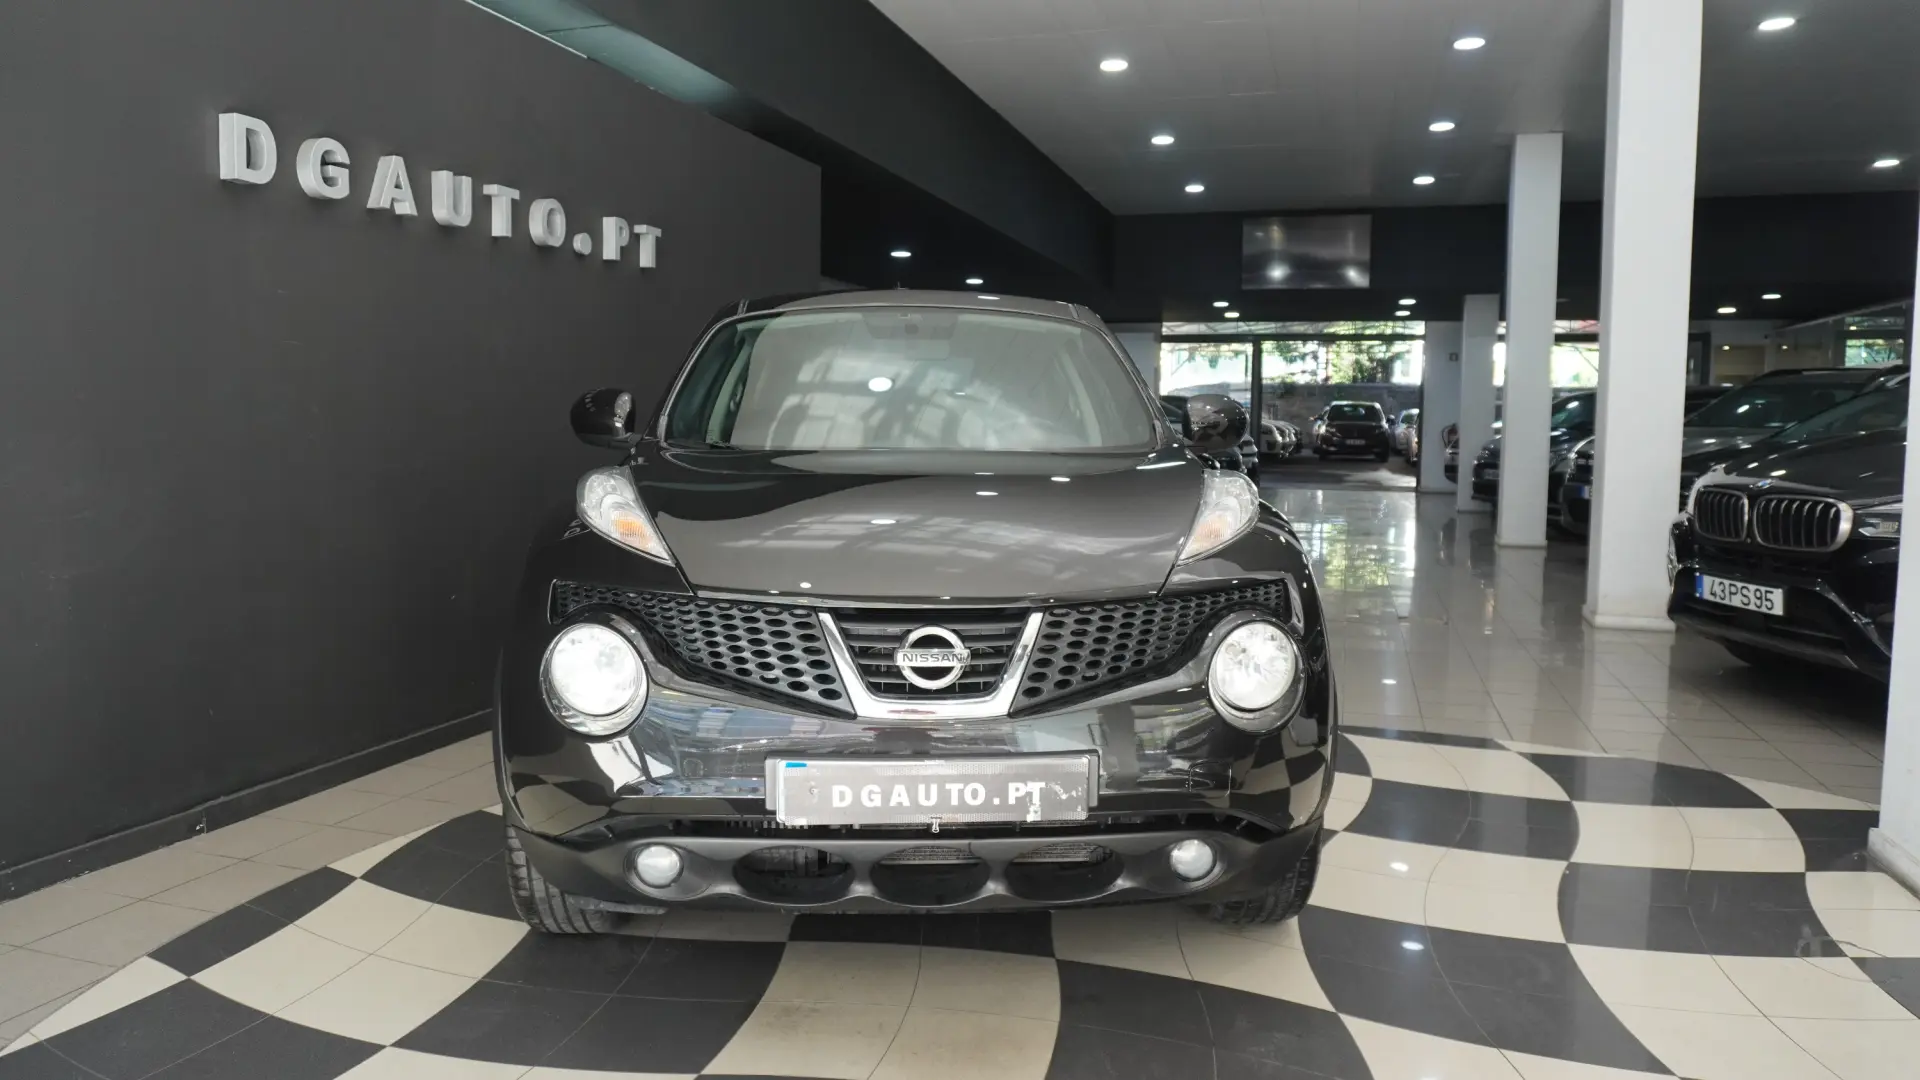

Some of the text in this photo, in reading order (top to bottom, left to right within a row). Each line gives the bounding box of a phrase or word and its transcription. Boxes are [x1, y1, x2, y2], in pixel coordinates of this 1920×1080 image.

[218, 112, 662, 268] DGAUTO.PT
[1709, 580, 1774, 611] 43PS95
[902, 653, 963, 662] NISSAN
[832, 781, 1046, 808] DGAUTO.PT
